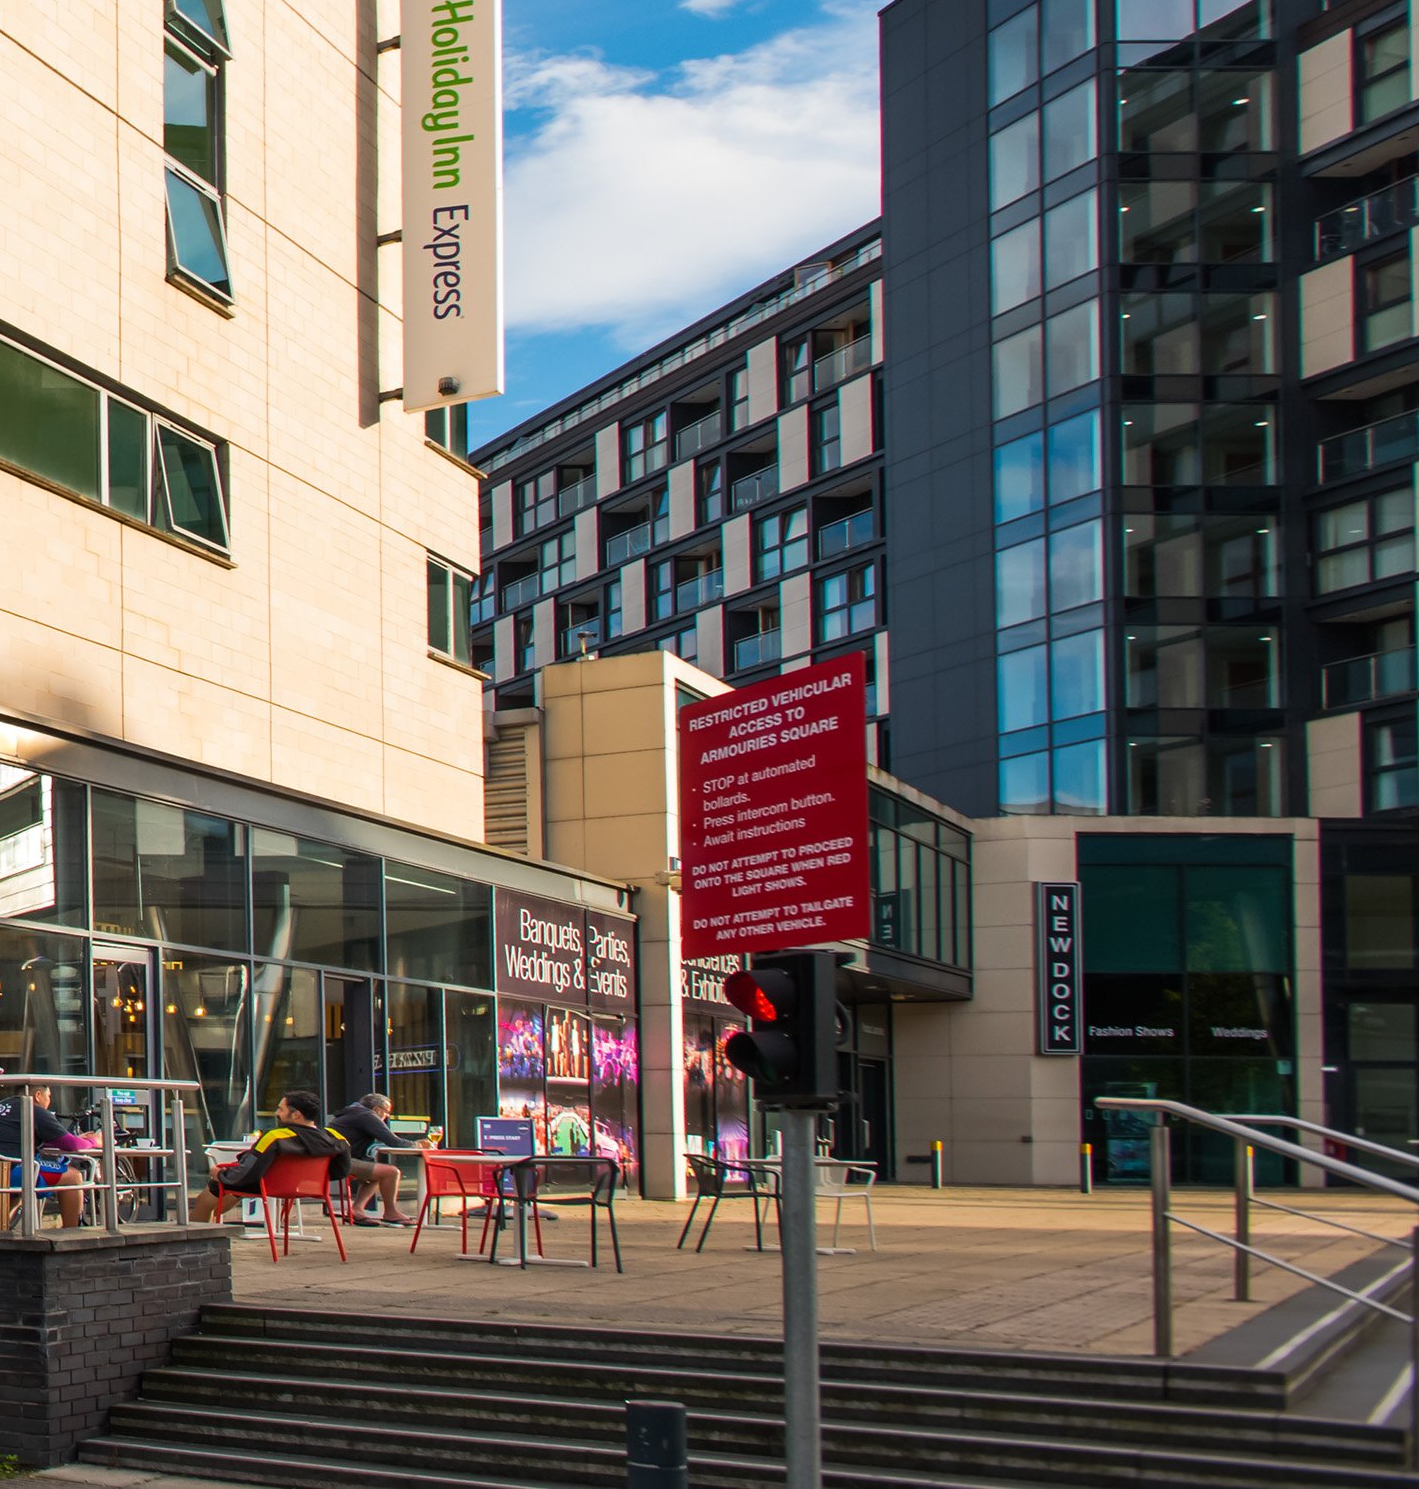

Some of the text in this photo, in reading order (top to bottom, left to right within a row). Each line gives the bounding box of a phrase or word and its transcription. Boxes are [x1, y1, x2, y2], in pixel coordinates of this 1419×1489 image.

[421, 0, 474, 320] Holiday Inn Express
[689, 672, 851, 731] RESTRICTED VEHICULAR
[700, 716, 838, 764] ARMOURIES SQUARE
[728, 706, 804, 738] ACCESS TO
[702, 754, 815, 793] STOP at automated
[703, 792, 750, 811] bollards.
[703, 792, 834, 829] Press intercom button.
[703, 817, 805, 846] Await instructions
[691, 836, 852, 875] DO NOT ATTEMPT TO PROCEED
[693, 852, 850, 889] ONTO THE SQUARE WHEN RED
[732, 875, 806, 896] LIGHT SHOWS.
[693, 896, 853, 929] DO NOT ATTEMPT TO TAILGATE
[716, 916, 825, 940] ANY OTHER VEHICLE.
[520, 908, 583, 957] Banquets,
[505, 943, 570, 993] Weddings
[573, 958, 585, 990] &
[1050, 895, 1071, 1041] NEW DOCK
[1089, 1026, 1268, 1040] Fashion Shows Weddings
